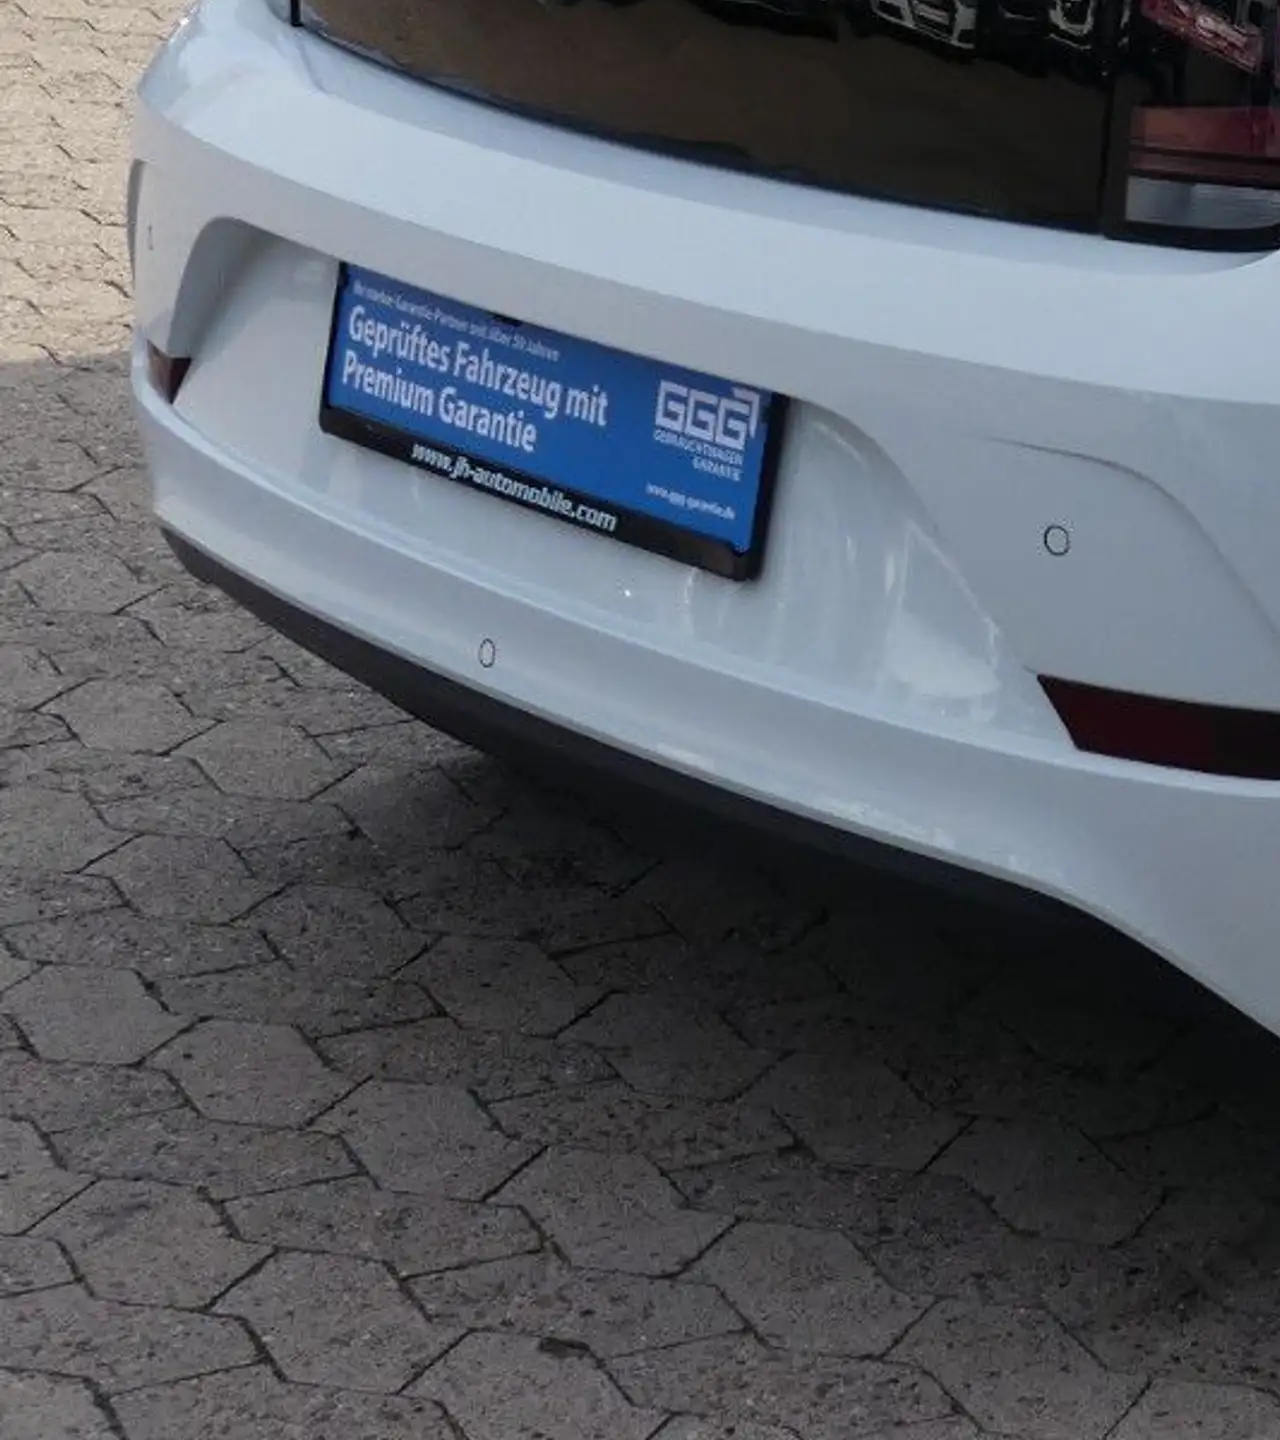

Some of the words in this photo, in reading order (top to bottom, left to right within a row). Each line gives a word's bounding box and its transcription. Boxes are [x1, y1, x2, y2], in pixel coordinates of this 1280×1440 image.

[341, 348, 436, 418] Premium
[438, 386, 538, 454] Garantie
[348, 305, 452, 375] Geprüftes
[453, 340, 562, 419] Fahrzeug
[565, 383, 609, 428] mit
[654, 379, 750, 452] GGG
[410, 443, 619, 533] www.jh-automobile.com
